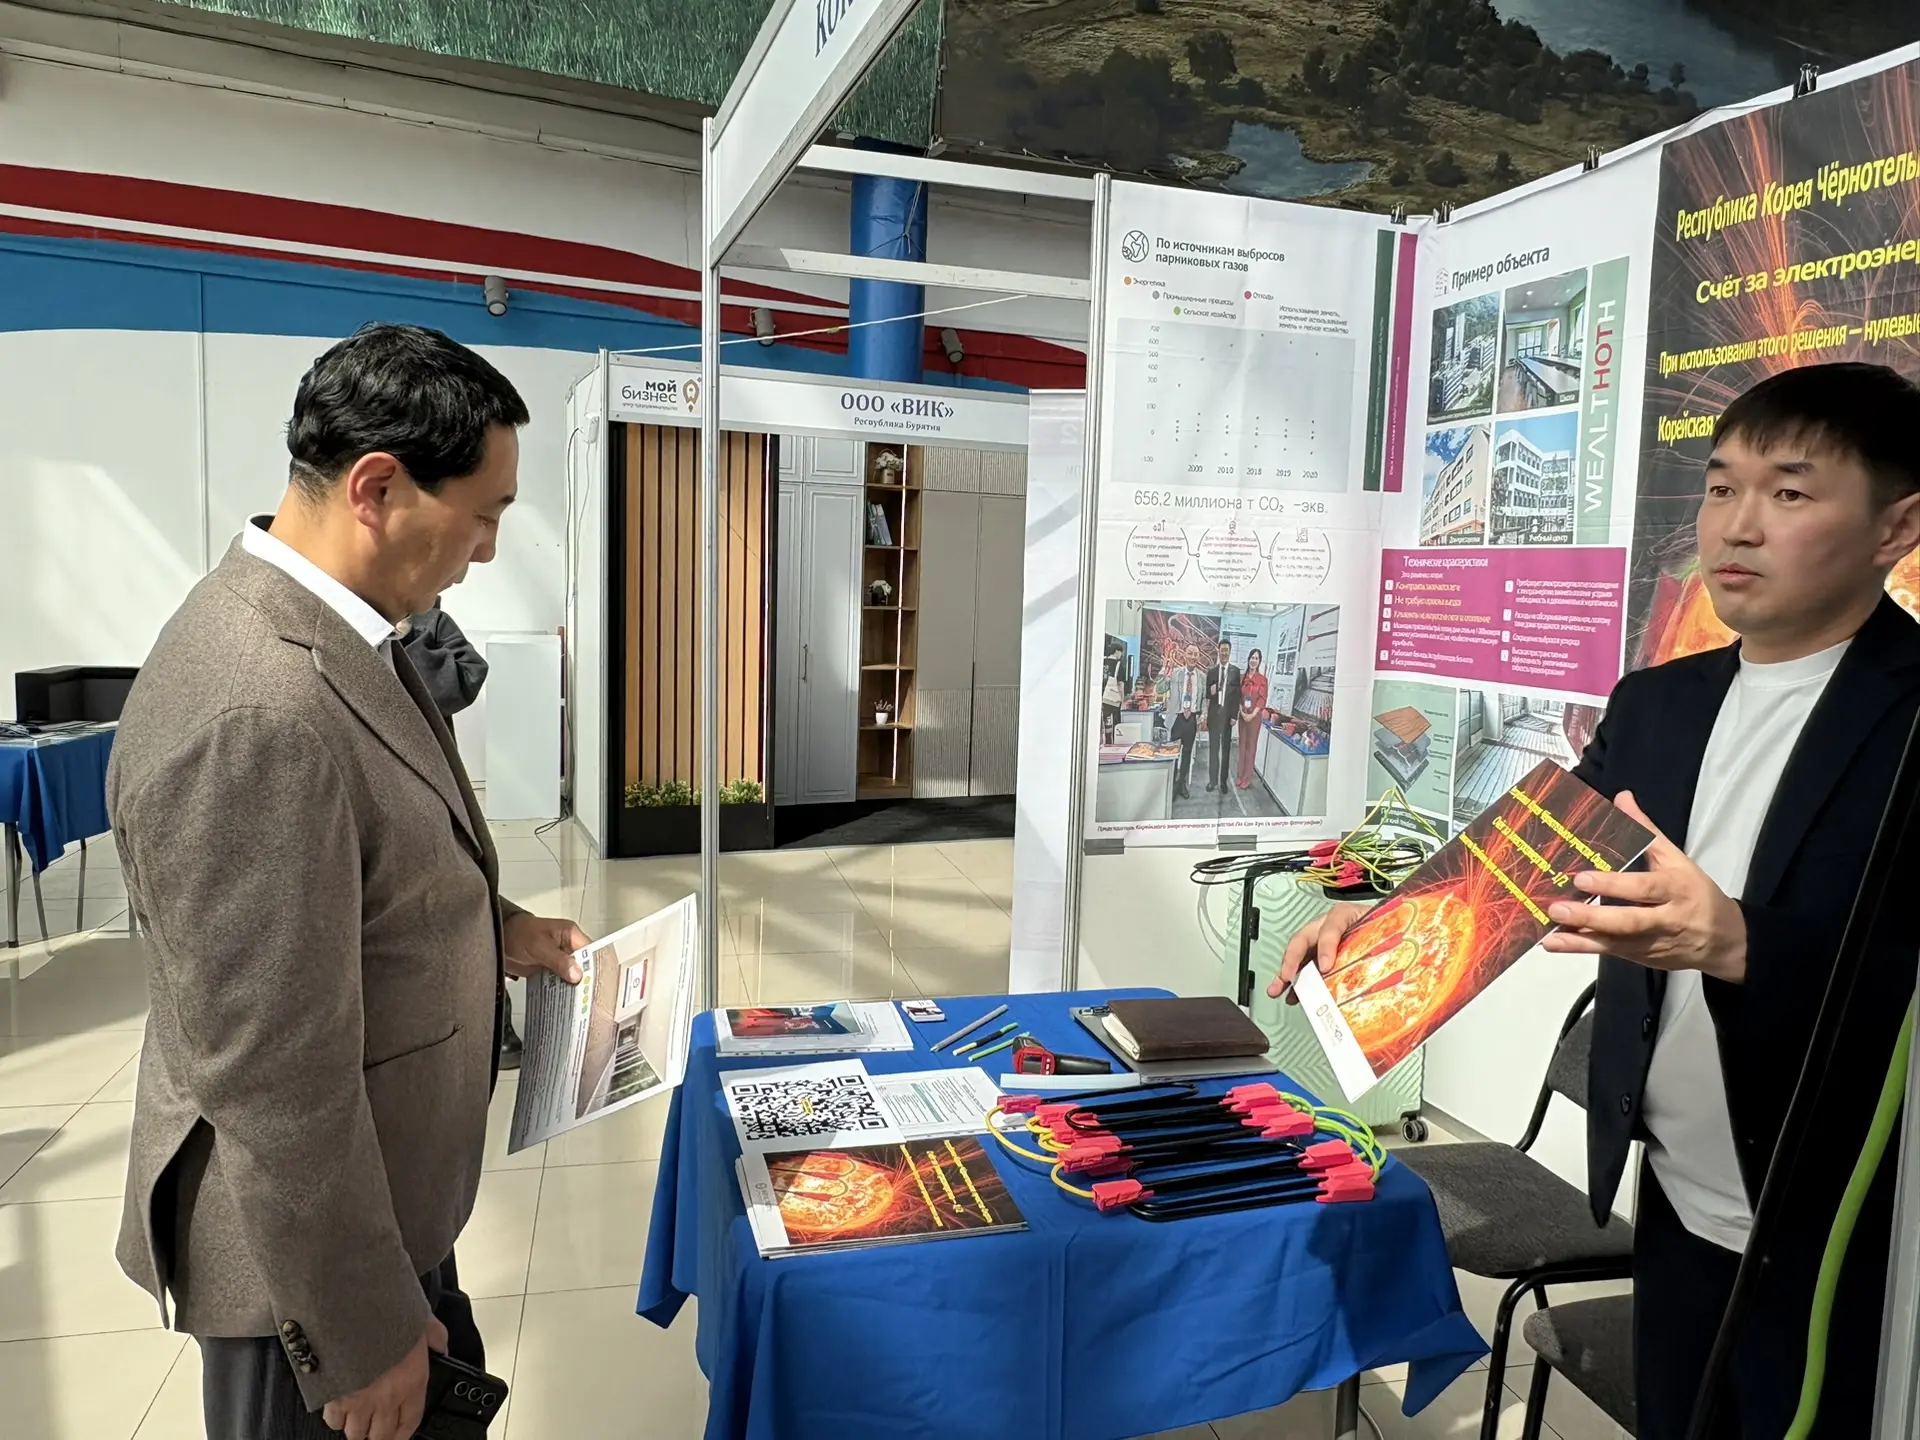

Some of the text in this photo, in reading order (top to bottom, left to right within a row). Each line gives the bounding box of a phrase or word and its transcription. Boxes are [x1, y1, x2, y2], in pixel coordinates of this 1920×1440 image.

[1676, 151, 1920, 242] Республика Корея Чёрнотель
[1156, 237, 1285, 262] По источникам выбросов
[1156, 253, 1249, 272] парниковых газов
[1451, 247, 1550, 289] Пример объекта
[1696, 275, 1744, 304] Счёт
[1745, 272, 1768, 294] за
[1659, 351, 1679, 378] При
[1680, 343, 1756, 371] использовании
[1757, 336, 1788, 358] этого
[1789, 324, 1848, 361] решения
[622, 385, 677, 403] бизнес
[645, 380, 677, 393] мой
[840, 392, 954, 418] ООО «ВИК»
[854, 416, 940, 431] Республика Бурятия
[1657, 410, 1714, 447] Корейская
[1174, 496, 1243, 510] миллиона
[1247, 498, 1254, 510] т
